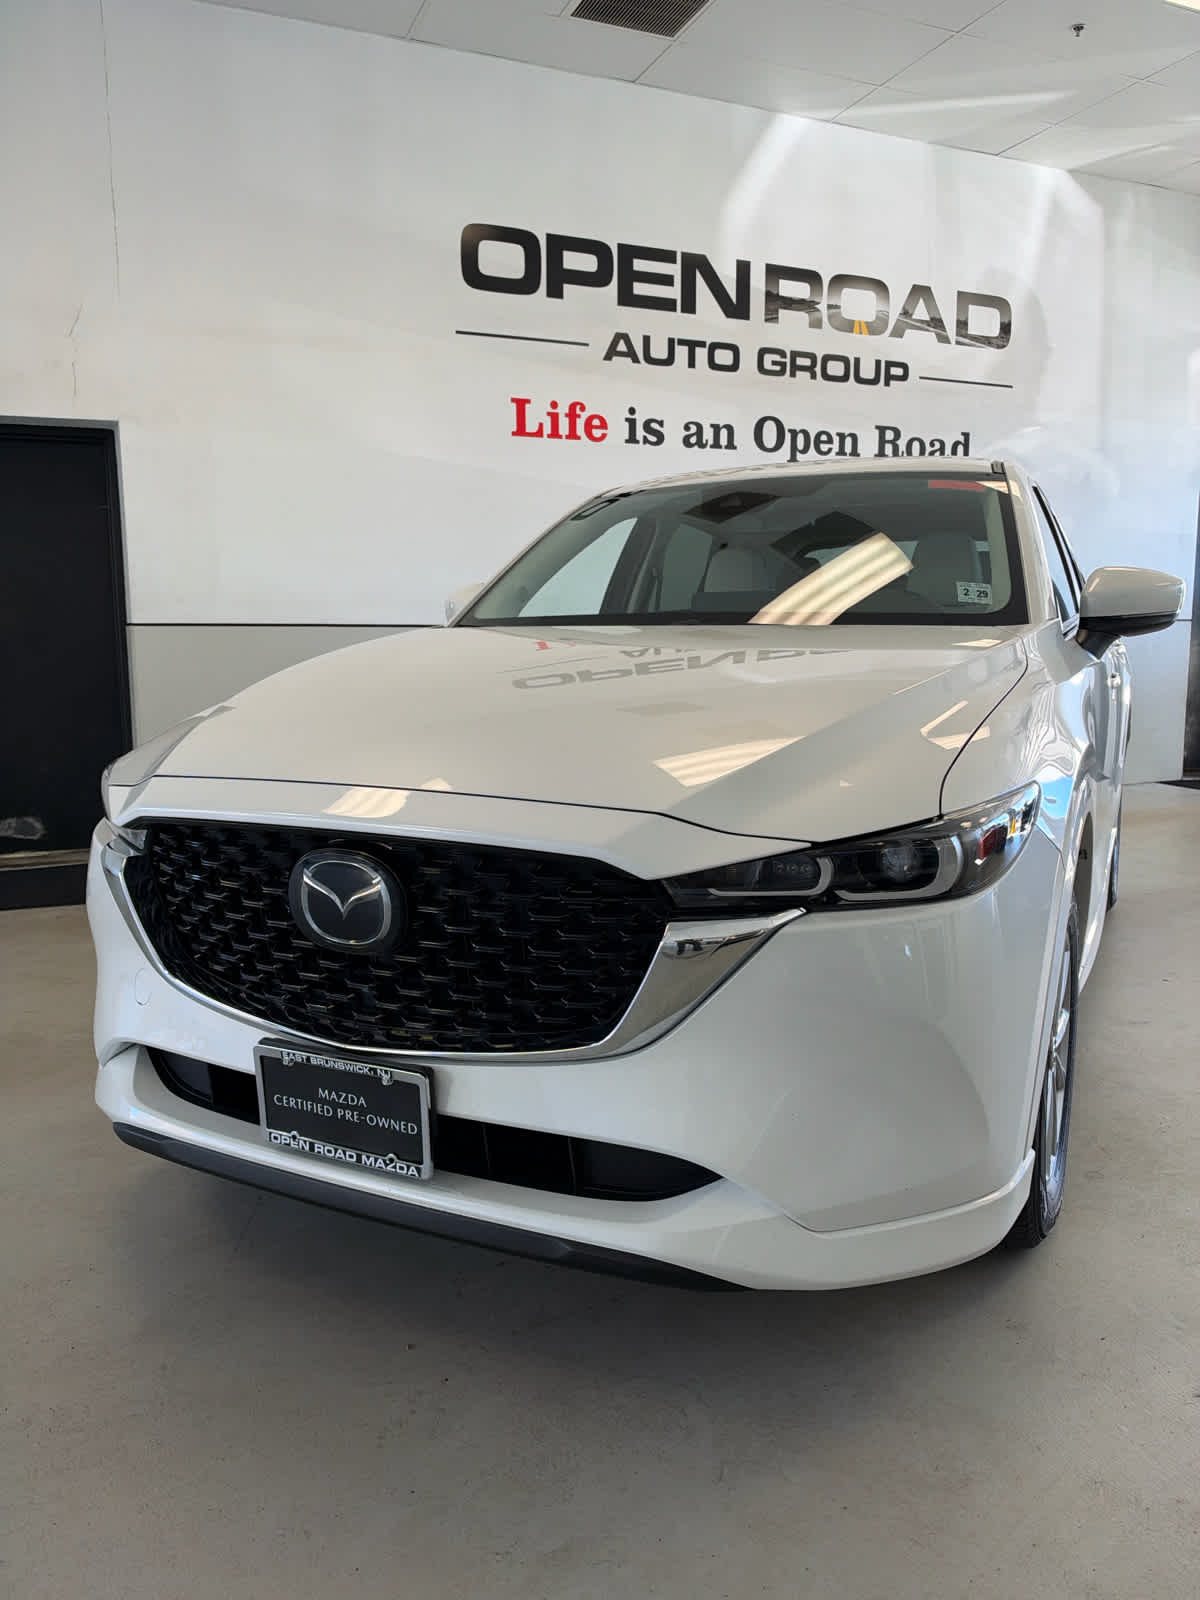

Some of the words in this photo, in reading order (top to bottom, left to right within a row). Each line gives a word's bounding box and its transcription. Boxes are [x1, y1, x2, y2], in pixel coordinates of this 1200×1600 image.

[603, 331, 740, 373] AUTO
[757, 347, 910, 387] GROUP
[510, 397, 609, 442] Life
[624, 407, 666, 447] is
[682, 419, 737, 451] an
[753, 415, 861, 463] Open
[874, 425, 971, 457] Road
[282, 1051, 307, 1065] EAST
[310, 1056, 374, 1076] BRUNSWICK,
[377, 1068, 391, 1080] NJ
[273, 1094, 333, 1118] CERTIFIED
[337, 1109, 418, 1135] PRE-OWNED
[318, 1087, 367, 1108] MAZDA
[270, 1133, 310, 1151] OPEN
[314, 1144, 357, 1162] ROAD
[361, 1156, 420, 1178] MAZDA
